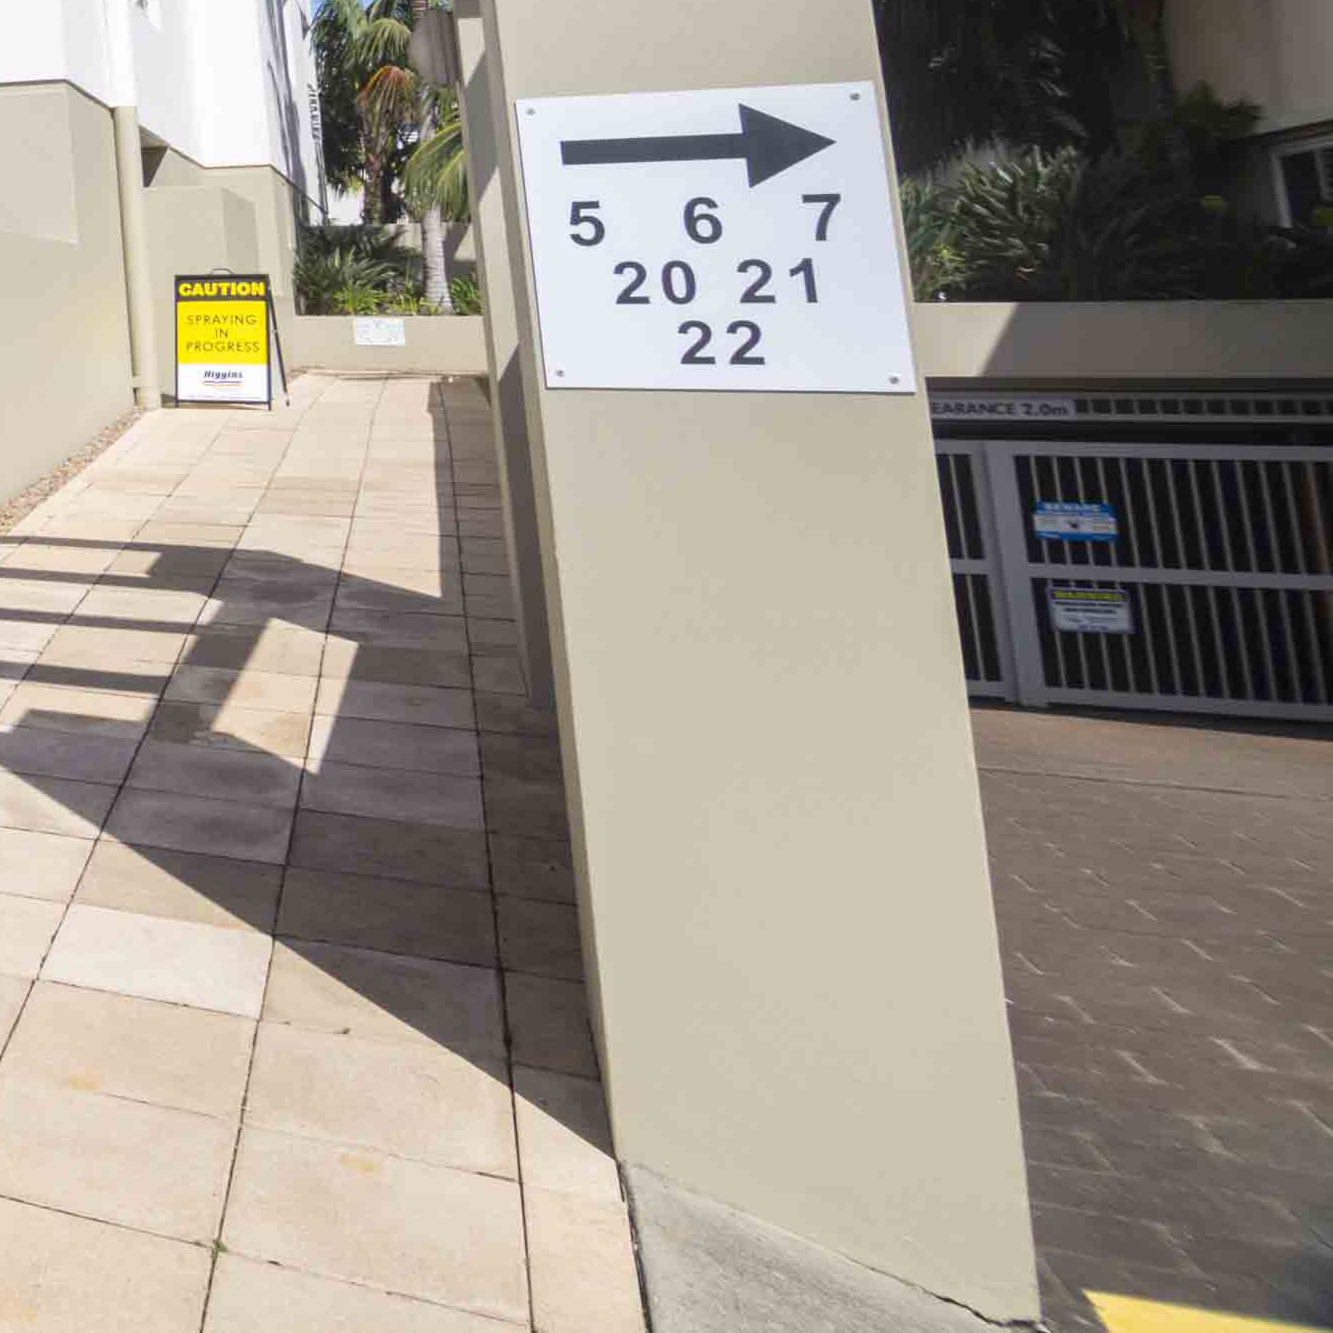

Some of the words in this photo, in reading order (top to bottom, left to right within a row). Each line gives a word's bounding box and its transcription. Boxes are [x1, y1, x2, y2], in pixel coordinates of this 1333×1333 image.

[568, 200, 606, 247] 5
[683, 196, 724, 245] 6
[801, 193, 842, 242] 7
[178, 281, 266, 297] CAUTION
[613, 259, 697, 306] 20
[736, 257, 820, 304] 21
[186, 313, 258, 326] SPRAYING
[214, 328, 230, 339] IN
[186, 340, 261, 354] PROGRESS
[677, 319, 766, 366] 22
[203, 369, 244, 380] Higgins
[931, 401, 1016, 416] EARANCE
[1019, 402, 1070, 418] 2.0m
